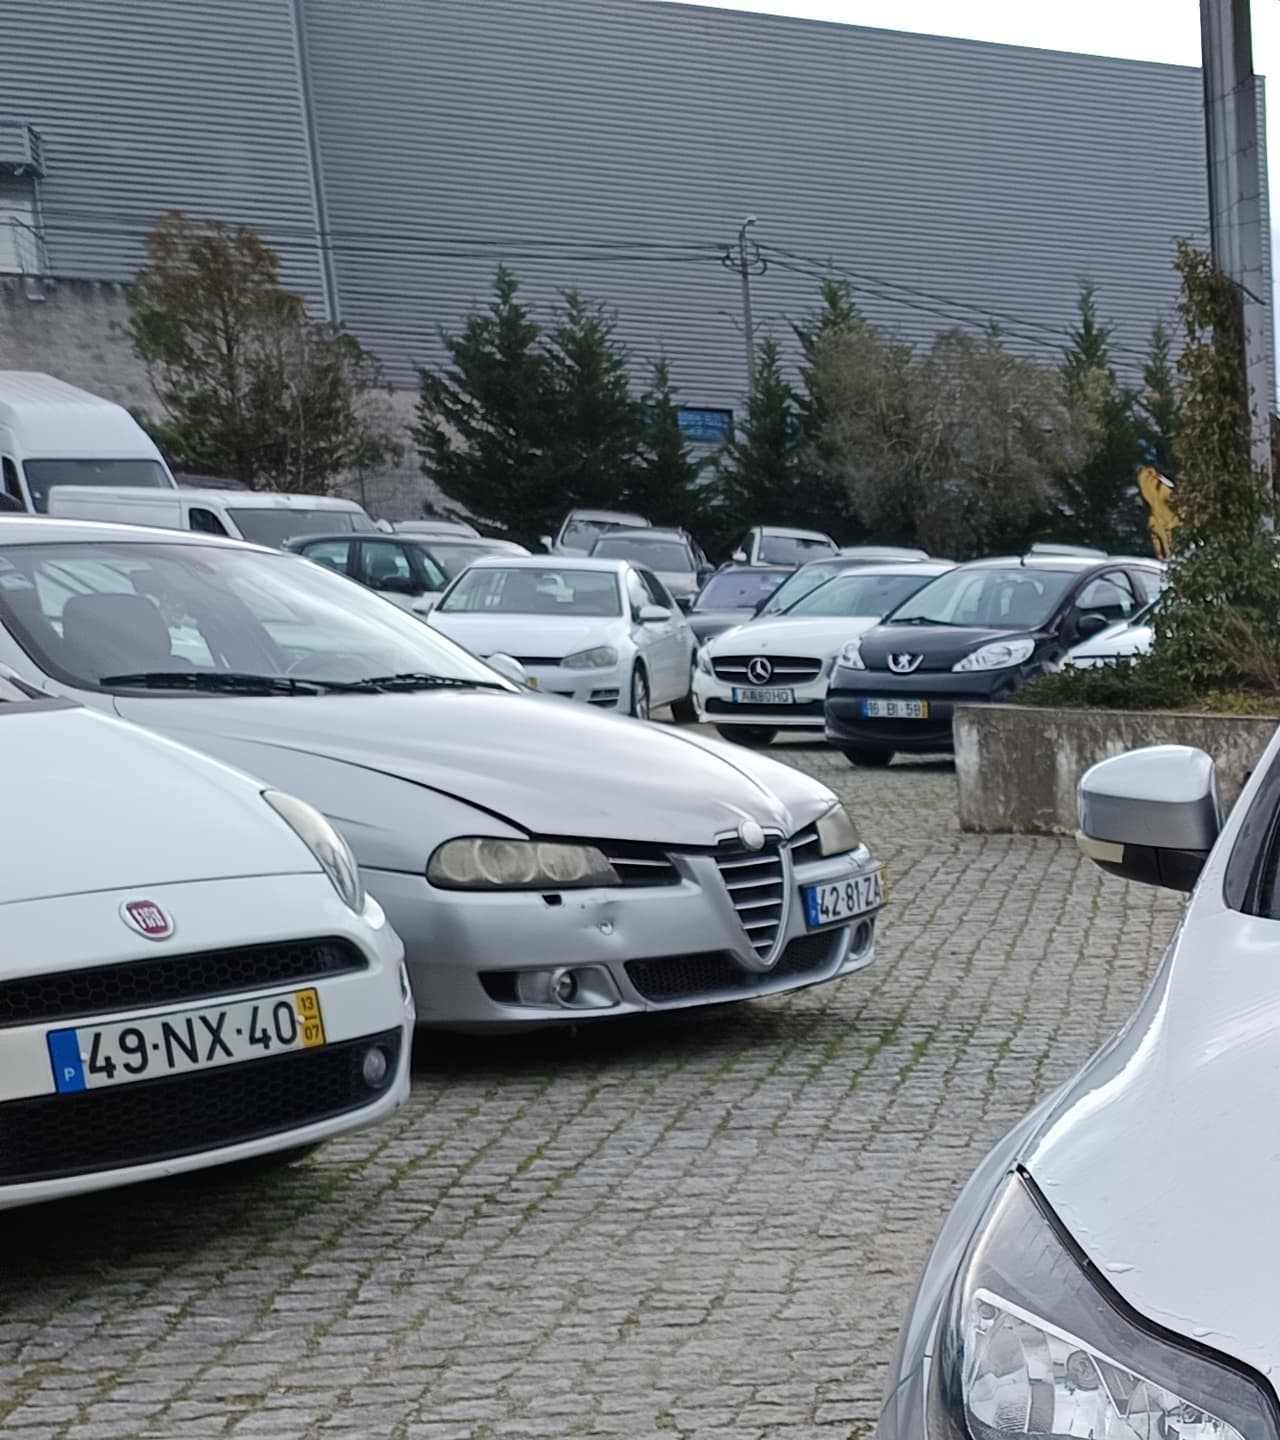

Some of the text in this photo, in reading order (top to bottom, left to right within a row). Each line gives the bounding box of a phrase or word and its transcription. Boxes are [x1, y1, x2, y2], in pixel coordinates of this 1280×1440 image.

[301, 995, 314, 1011] 13
[304, 1024, 320, 1041] 07
[64, 1067, 75, 1082] P
